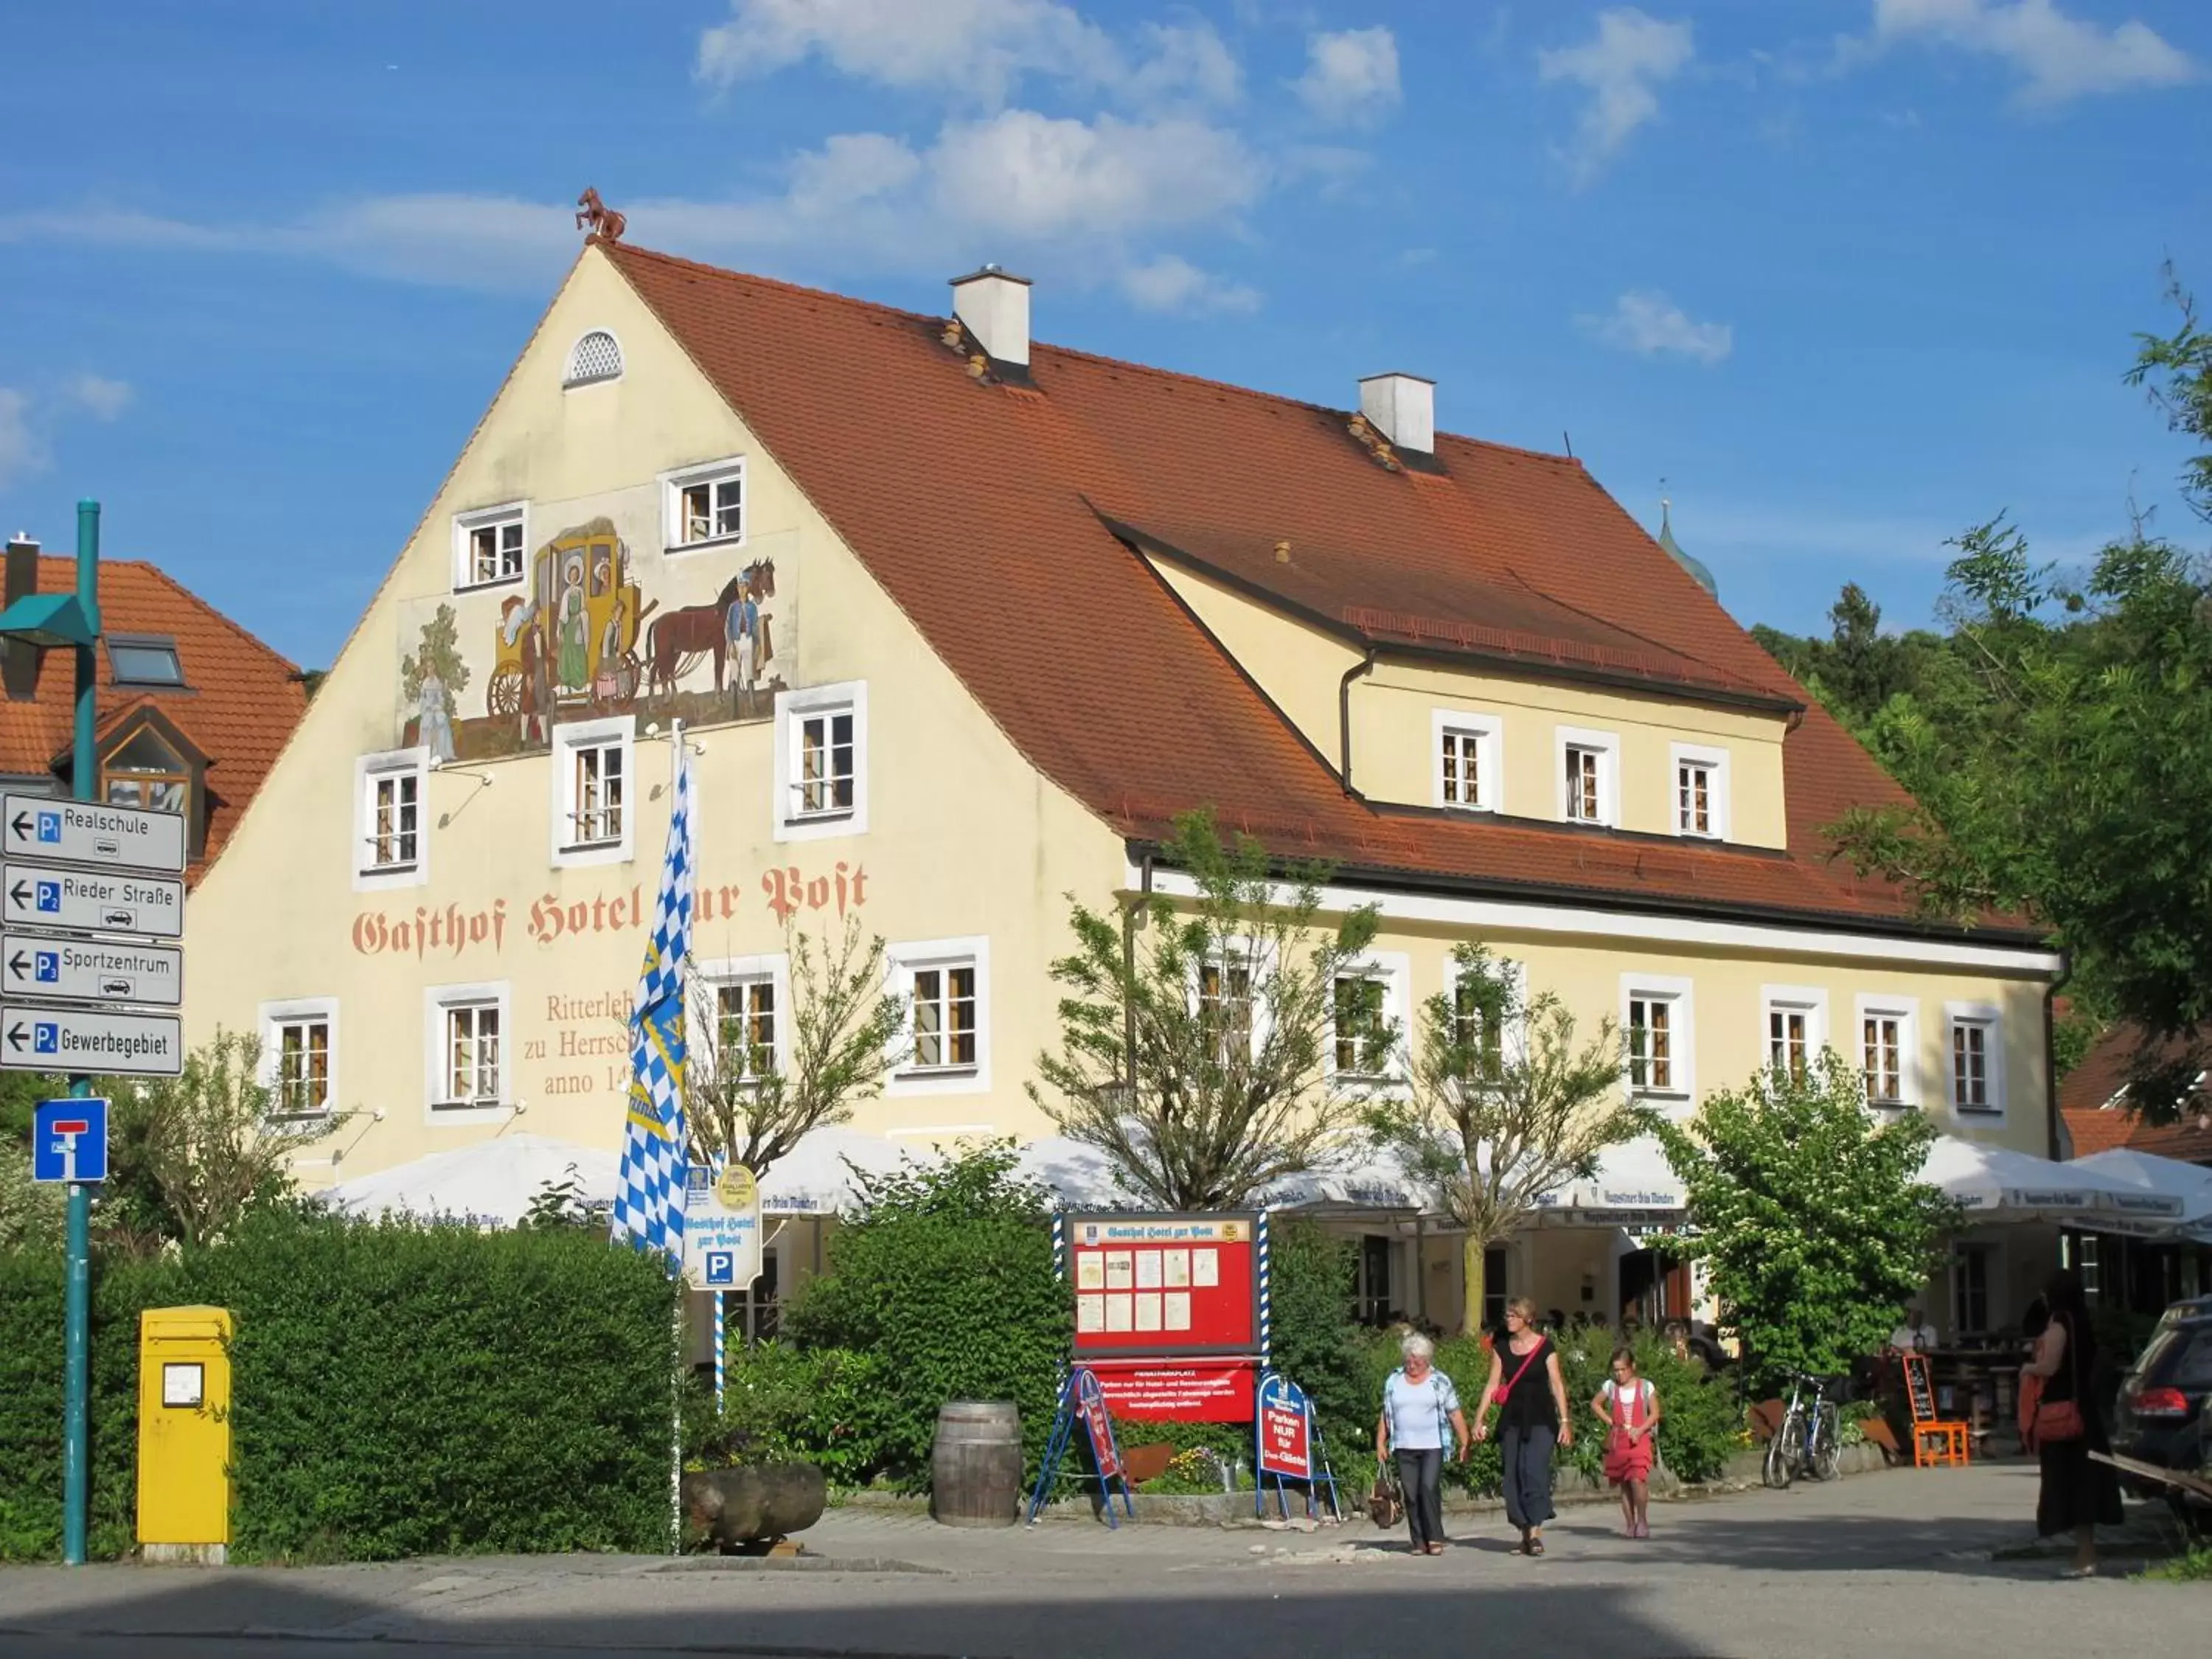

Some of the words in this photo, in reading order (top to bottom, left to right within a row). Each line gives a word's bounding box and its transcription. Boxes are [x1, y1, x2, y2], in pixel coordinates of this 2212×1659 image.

[65, 809, 149, 835] Realschule
[64, 879, 115, 900] Rieder
[123, 885, 173, 905] Straße
[528, 882, 644, 945] Hotel
[693, 885, 740, 923] ur
[63, 948, 170, 974] Sportzentrum
[546, 990, 635, 1022] Ritterleh
[62, 1029, 167, 1059] Gewerbegebiet
[524, 1040, 546, 1060] zu
[545, 1074, 594, 1095] anno
[711, 1256, 729, 1276] P
[1267, 1411, 1300, 1428] Parken
[1273, 1424, 1296, 1439] NUR
